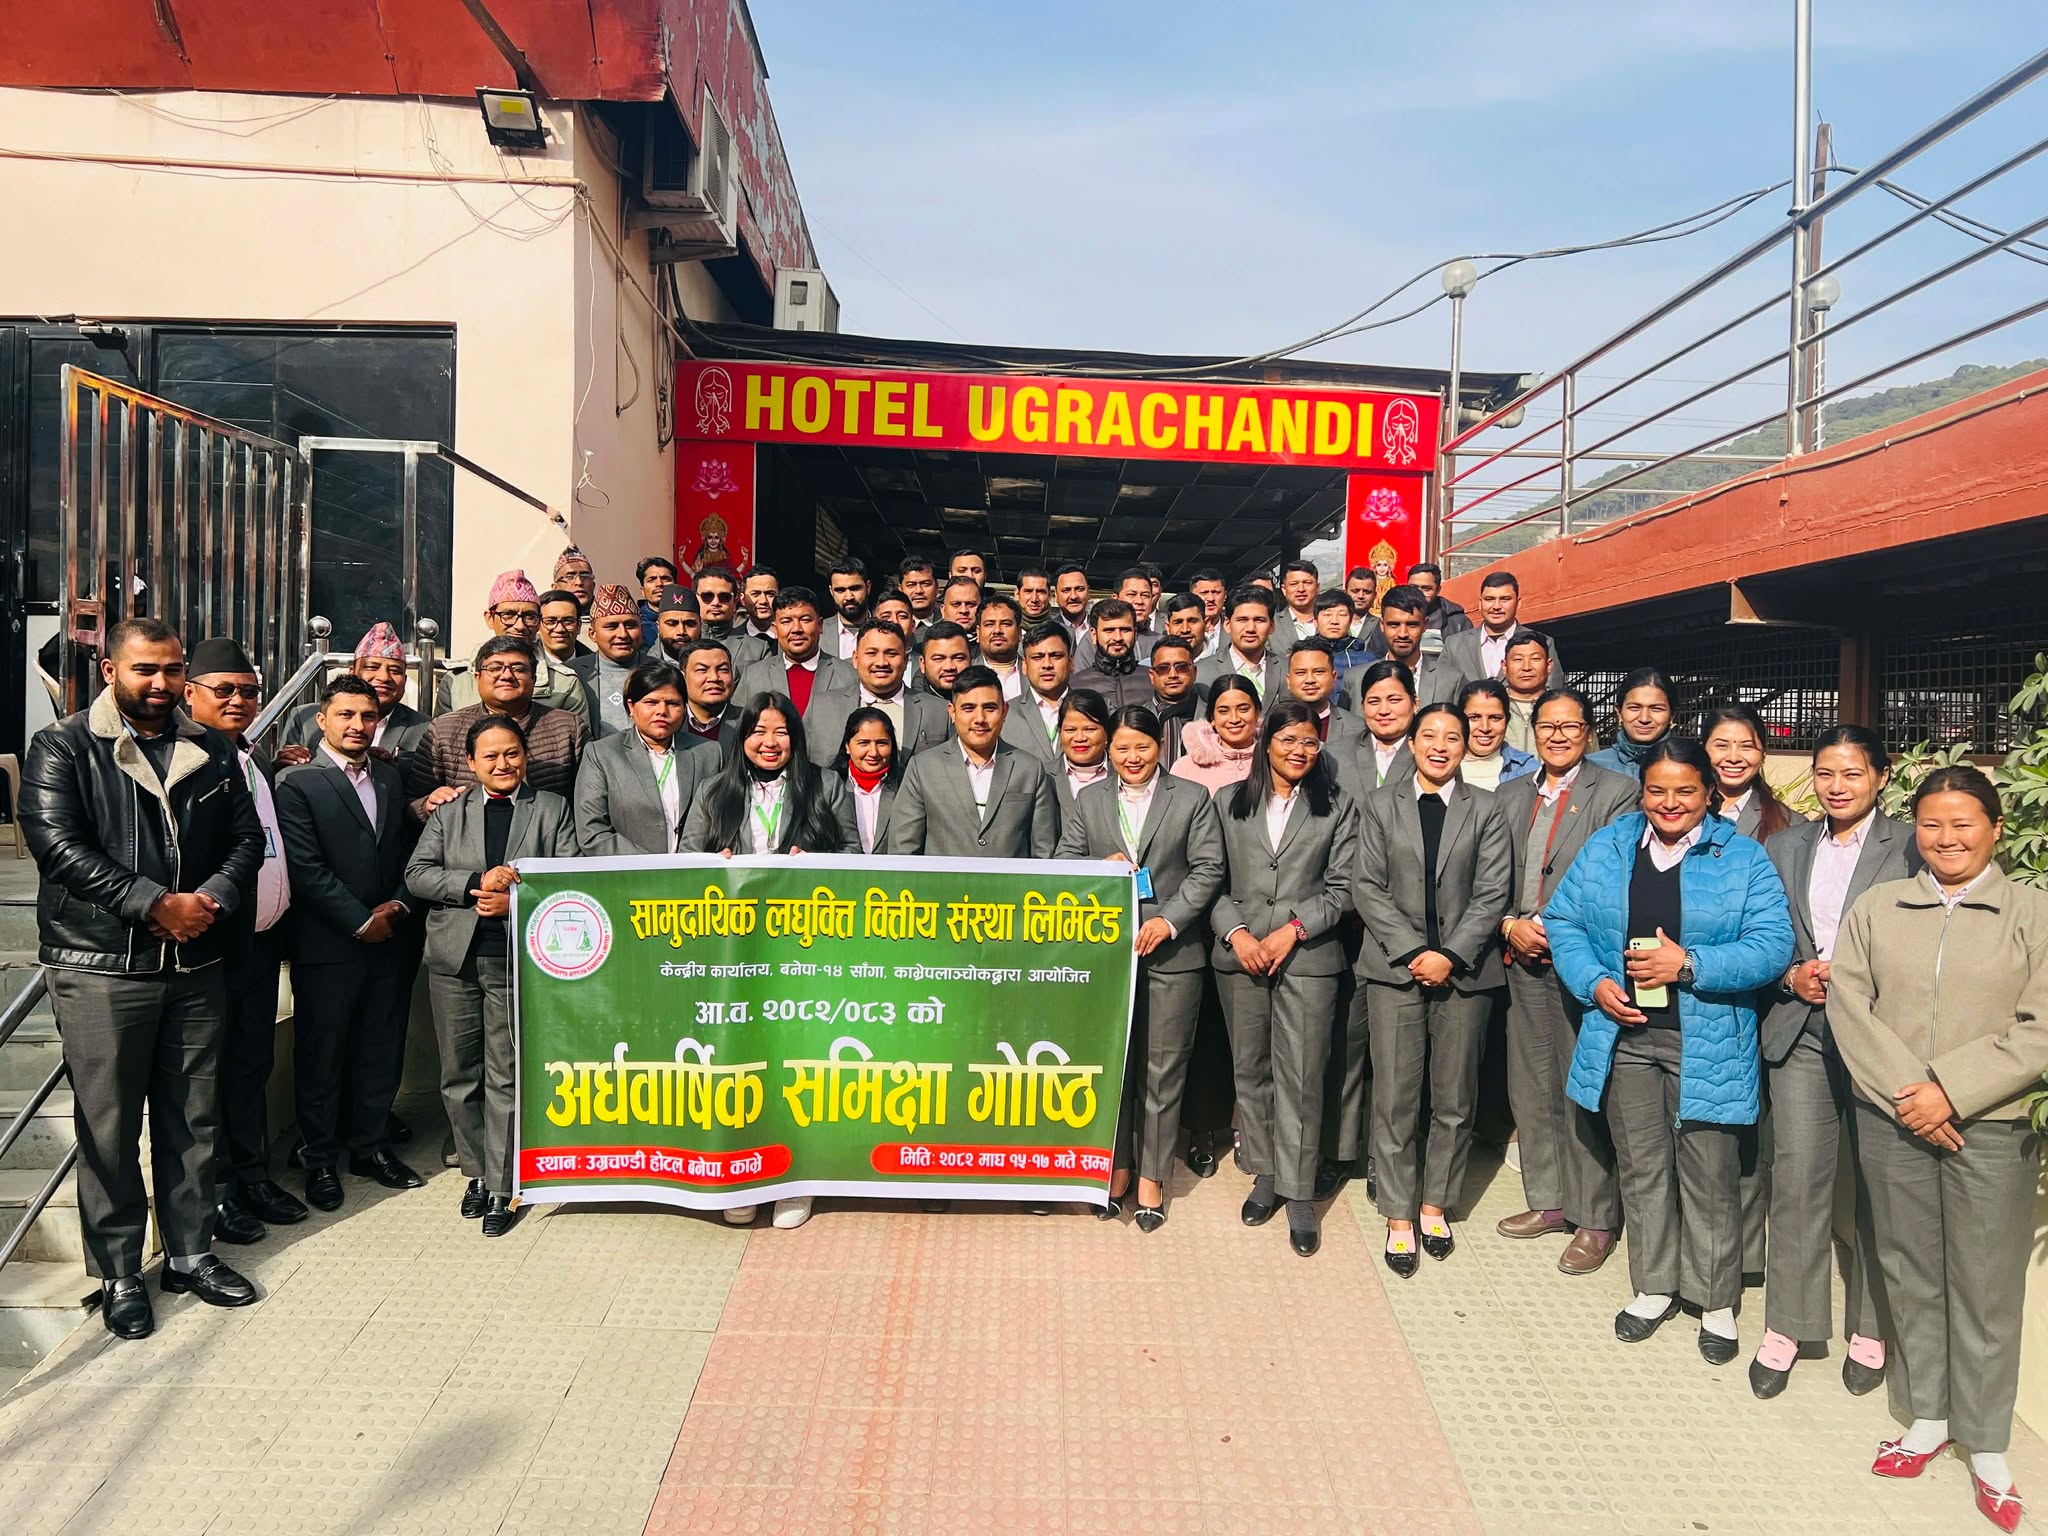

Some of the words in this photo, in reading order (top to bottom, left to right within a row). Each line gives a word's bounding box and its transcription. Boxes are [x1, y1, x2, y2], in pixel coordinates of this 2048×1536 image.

[744, 375, 943, 438] HOTEL
[967, 386, 1374, 458] UGRACHANDI
[629, 884, 758, 948] सामुदायिक
[864, 886, 939, 942] वित्तीय
[946, 894, 1016, 944] संस्था
[1023, 890, 1123, 944] लिमिटेड
[659, 961, 706, 979] केन्द्रीय
[1028, 966, 1091, 984] आयोजित
[695, 1000, 754, 1024] आ.व.
[762, 998, 897, 1025] २०८२/०८३
[907, 996, 946, 1025] को
[544, 1037, 768, 1131] अर्धवार्षिक
[782, 1036, 953, 1135] समिक्षा
[967, 1040, 1104, 1129] गोष्ठि
[585, 1150, 646, 1172] उग्रचण्डी
[730, 1152, 763, 1176] काभ्रे
[939, 1152, 974, 1168] २०८२
[978, 1152, 1005, 1168] माघ
[1054, 1150, 1076, 1169] गते
